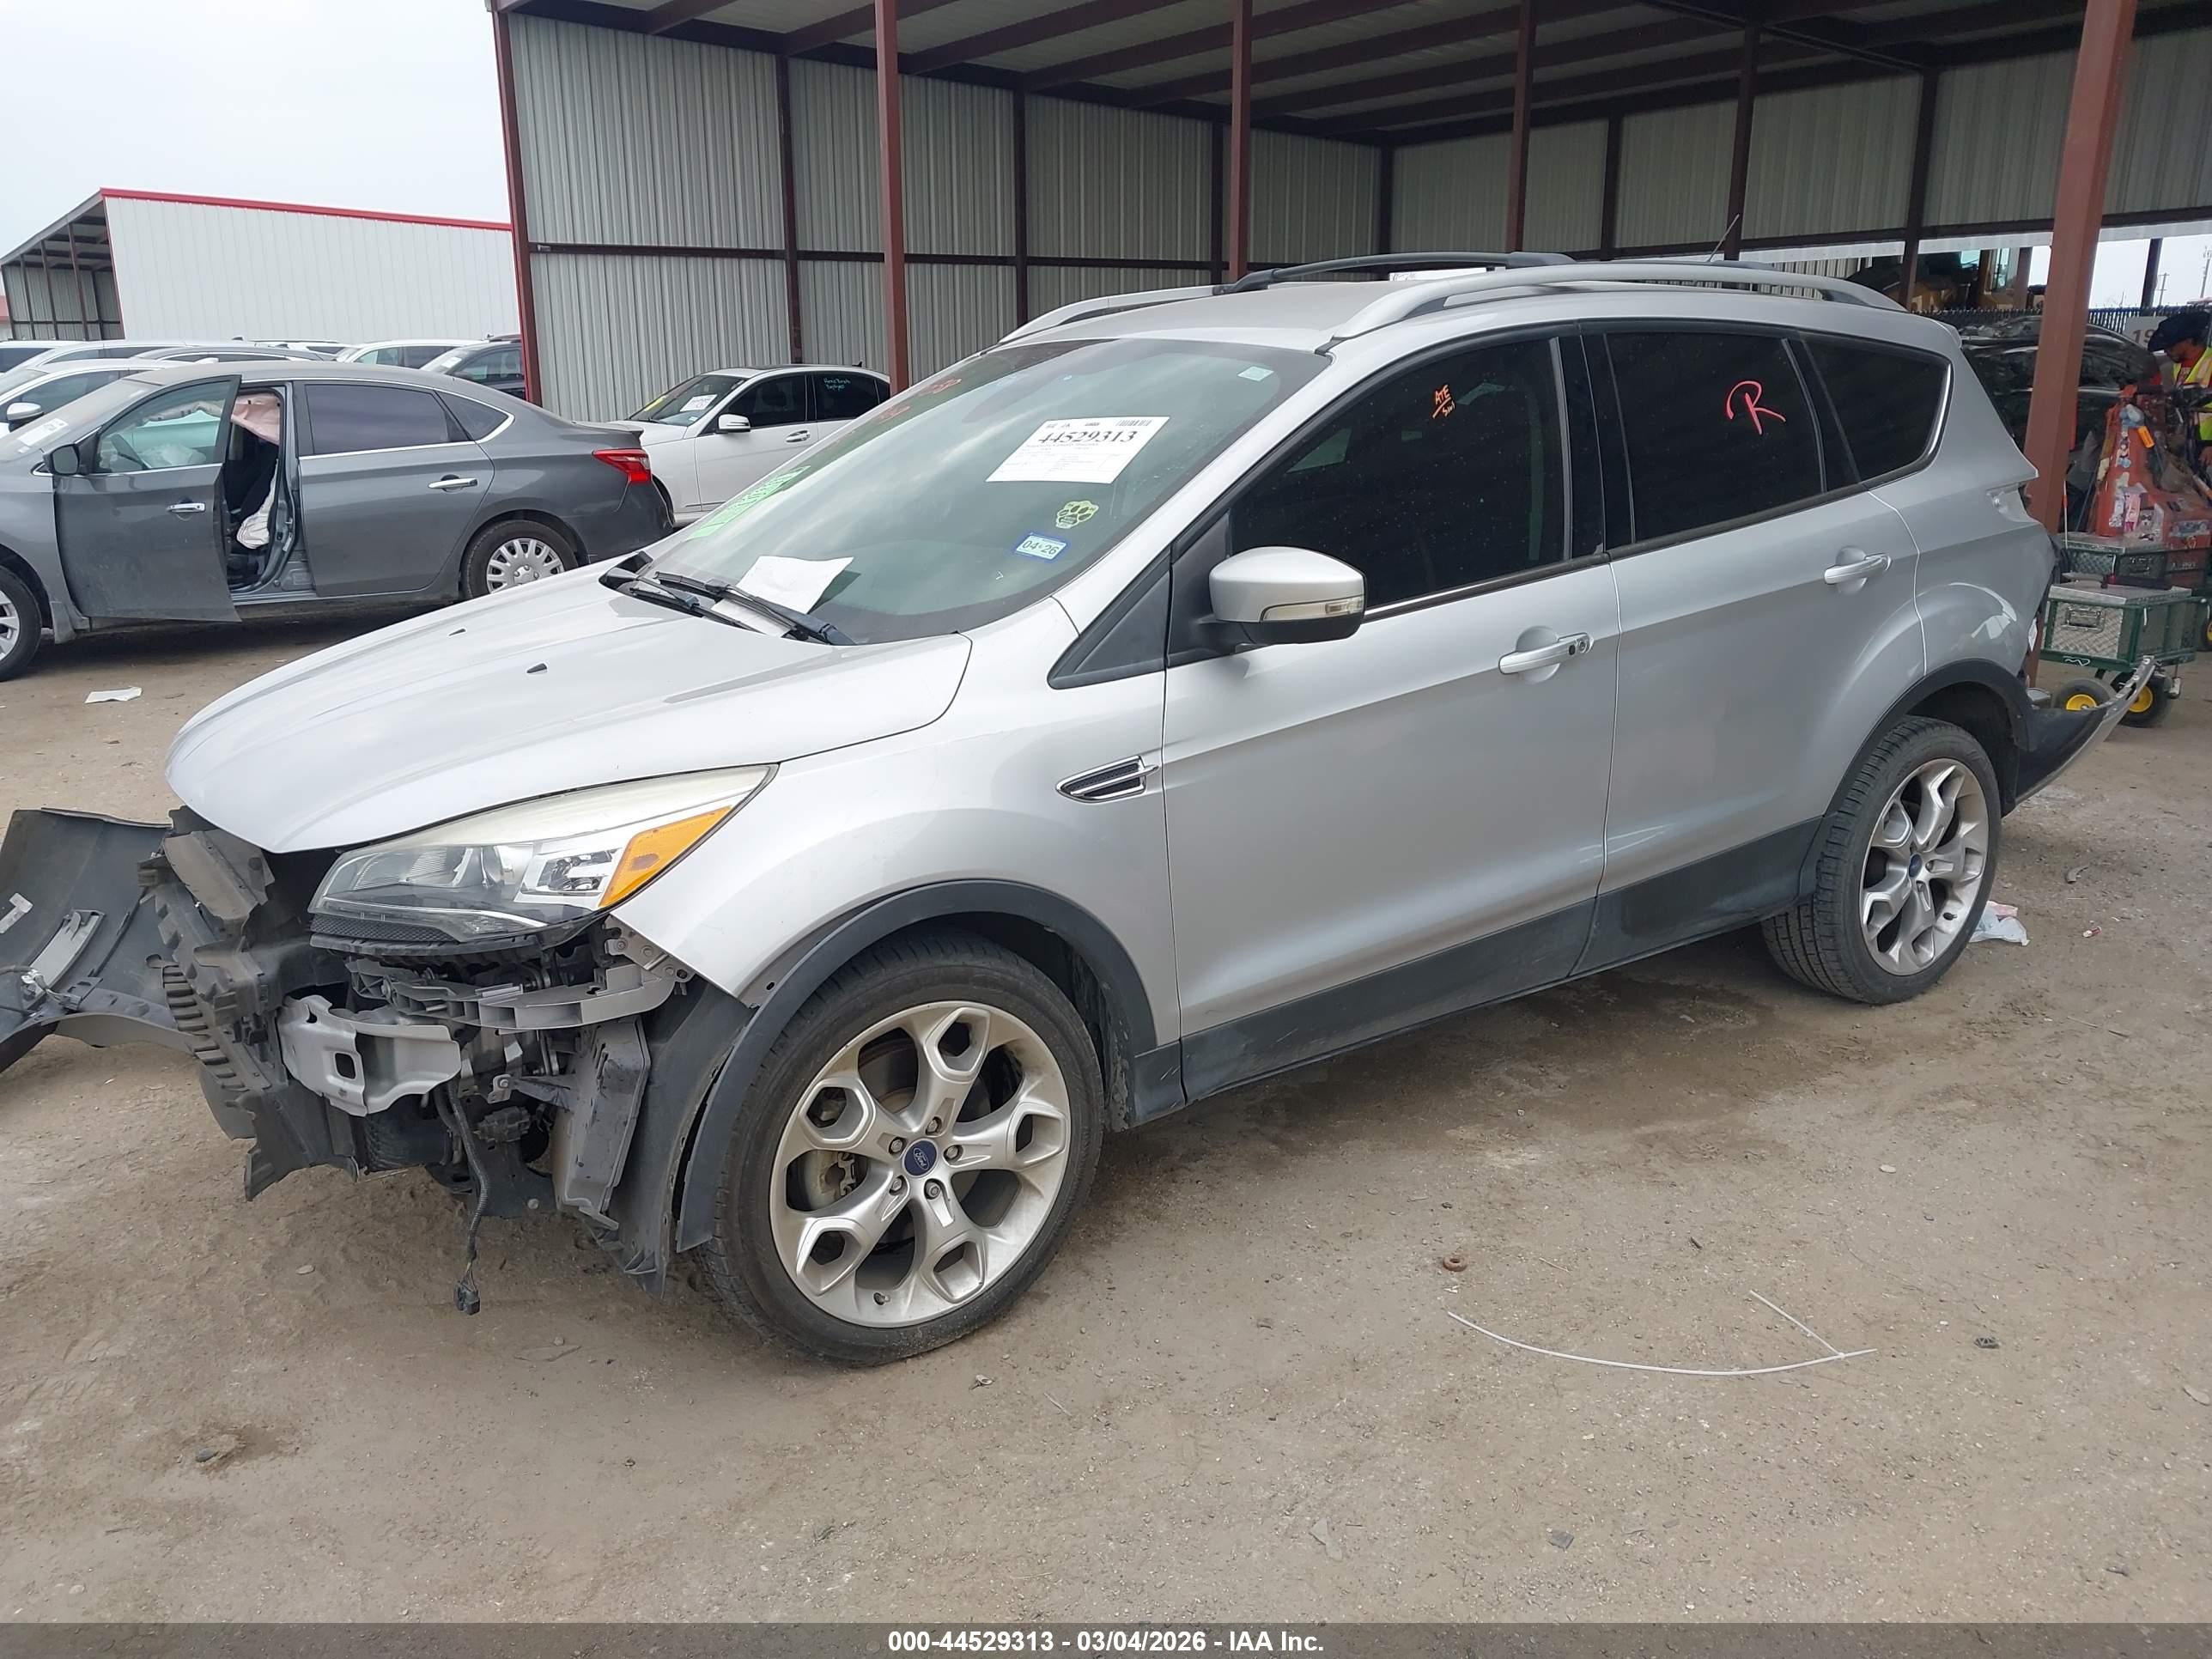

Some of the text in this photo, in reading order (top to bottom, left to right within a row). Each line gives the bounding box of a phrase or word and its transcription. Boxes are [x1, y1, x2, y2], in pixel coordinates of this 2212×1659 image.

[1726, 380, 1786, 435] R
[1038, 430, 1138, 443] 44529313
[914, 1151, 928, 1168] Ford
